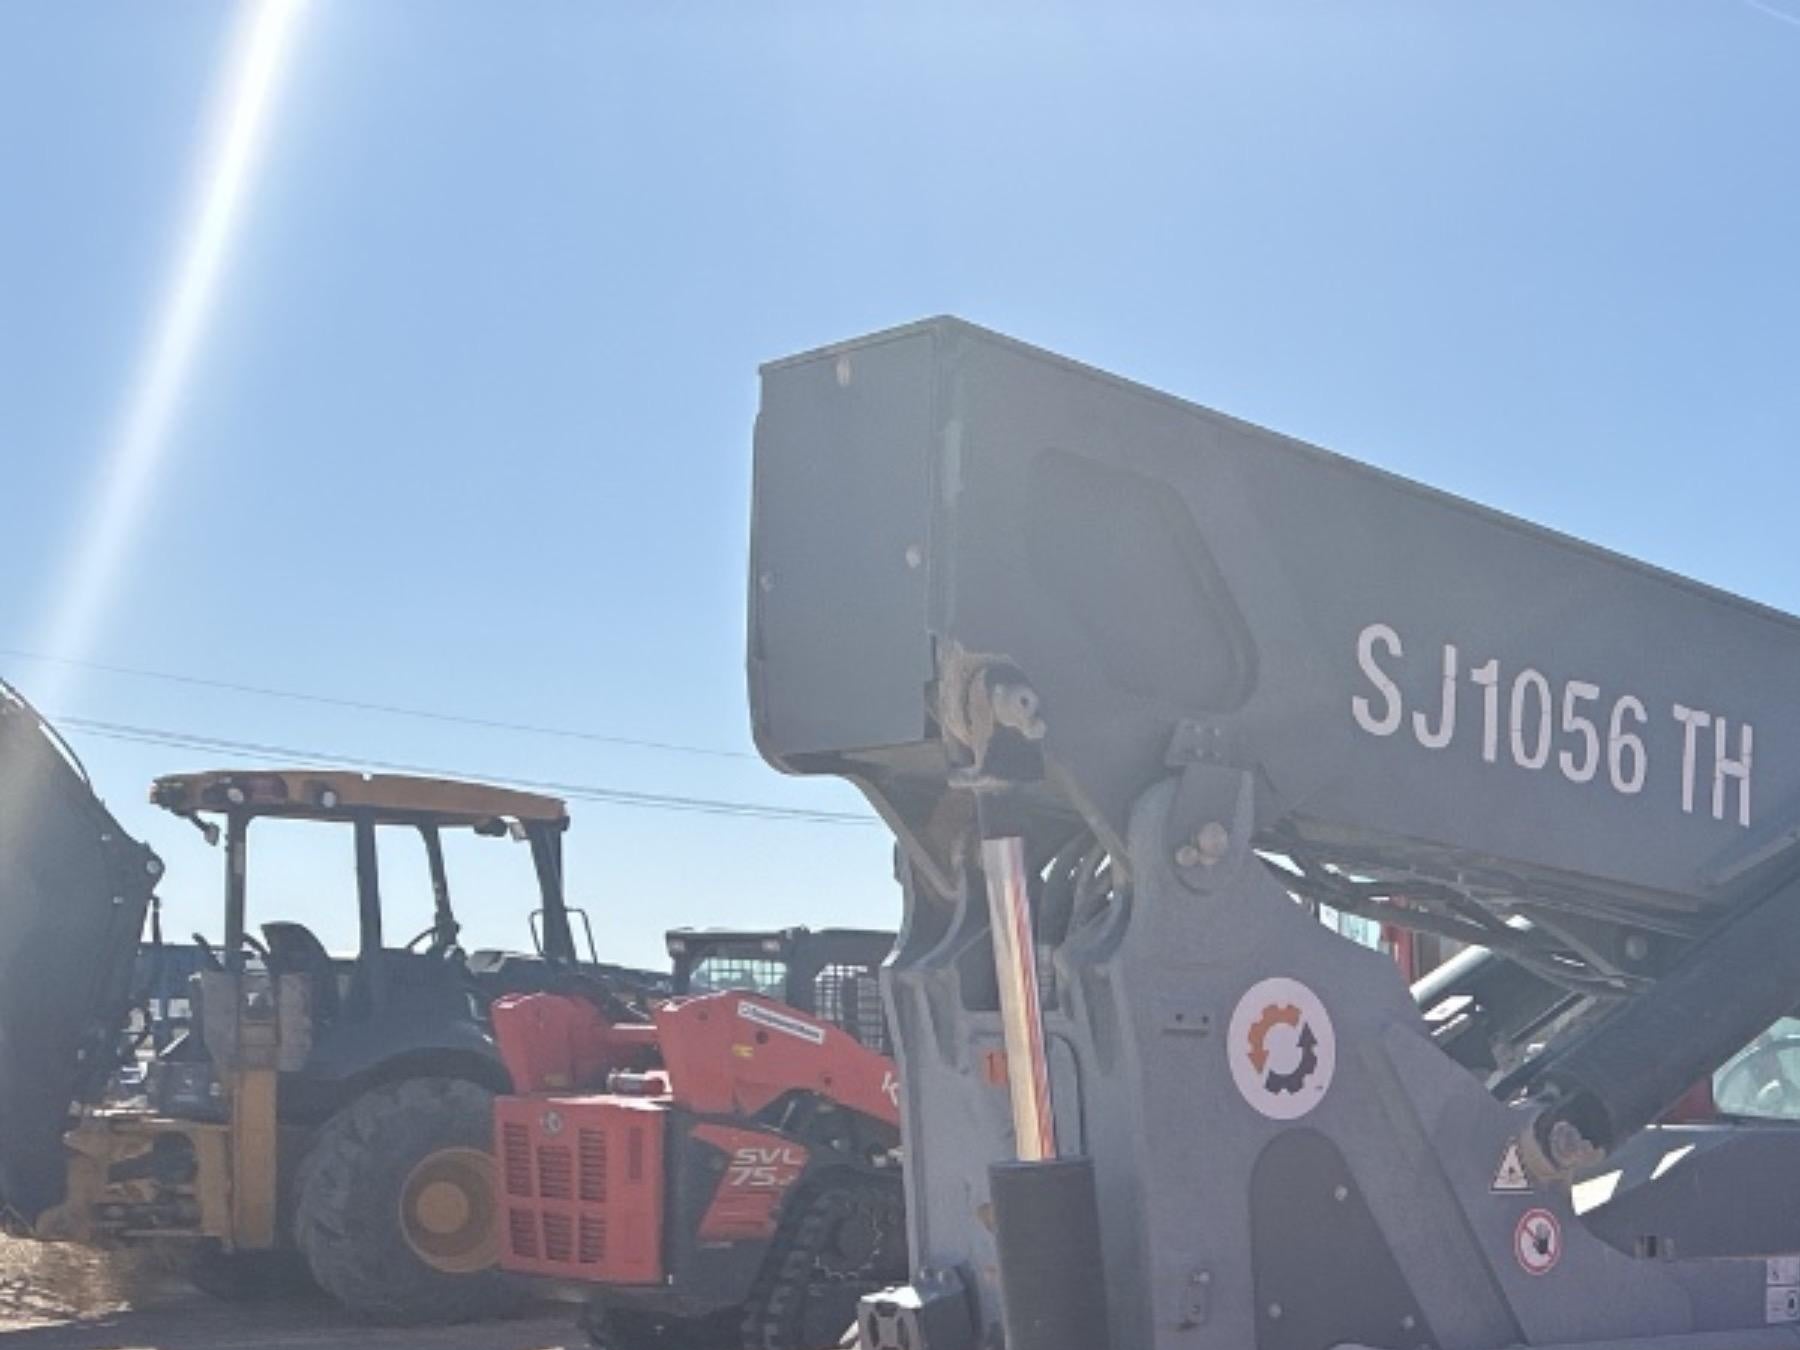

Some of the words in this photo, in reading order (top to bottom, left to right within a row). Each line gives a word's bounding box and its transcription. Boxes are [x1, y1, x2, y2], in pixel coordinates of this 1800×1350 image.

[1352, 623, 1648, 794] SJ1056
[1673, 703, 1753, 828] TH
[733, 1147, 803, 1166] SVL
